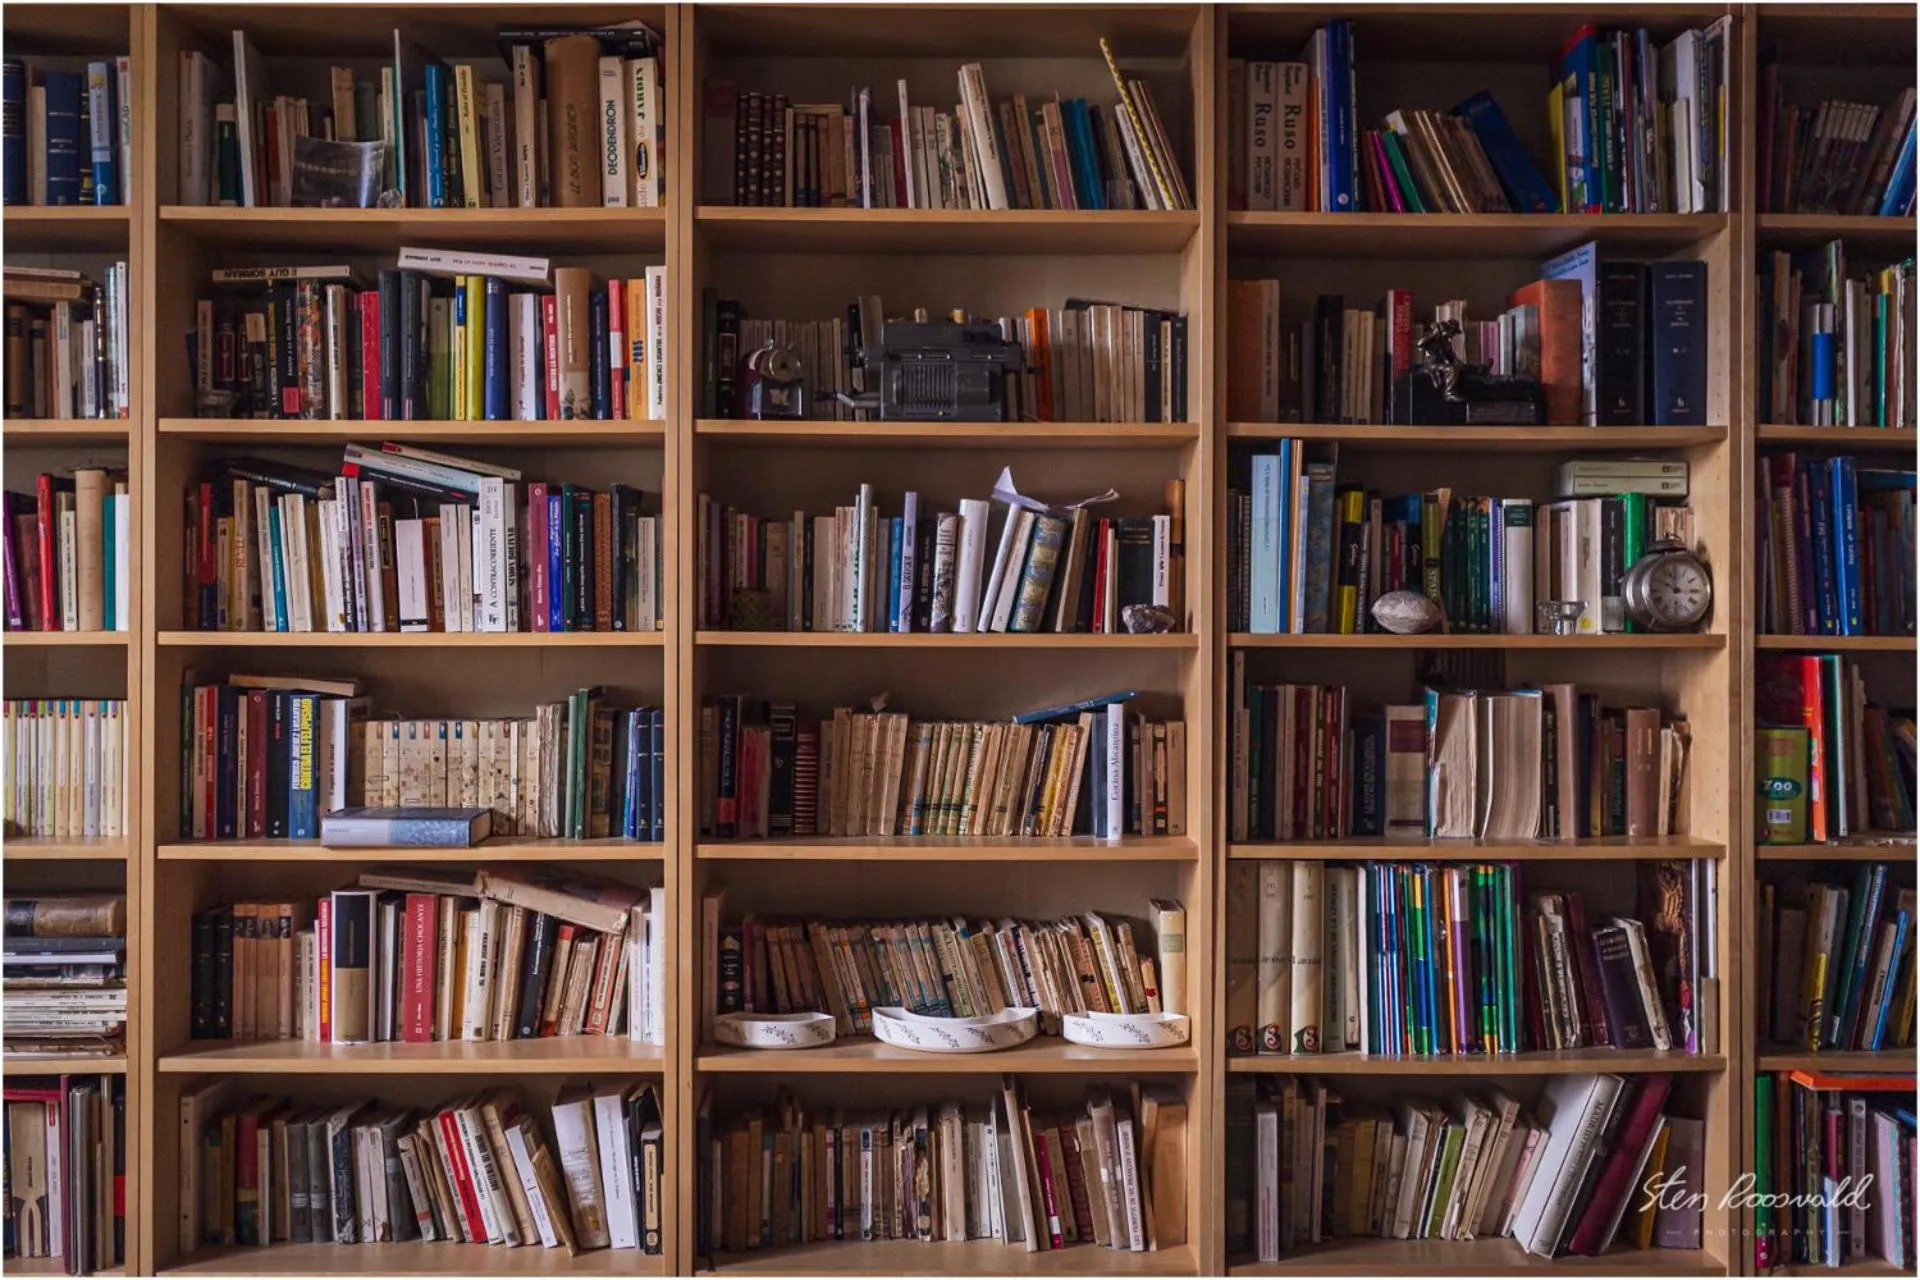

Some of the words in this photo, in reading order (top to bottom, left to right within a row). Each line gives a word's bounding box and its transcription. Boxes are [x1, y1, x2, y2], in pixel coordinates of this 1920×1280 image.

[635, 66, 645, 120] JARDIN
[605, 99, 618, 176] DEODENDRON
[1253, 103, 1273, 148] Ruso
[1284, 104, 1303, 149] Ruso
[224, 267, 266, 279] SORMAN
[269, 267, 289, 276] GUY
[488, 528, 498, 598] CONTRACORRIENTE
[489, 600, 498, 608] A
[301, 697, 312, 744] FELIPISMO
[301, 754, 312, 790] CONTRA
[416, 902, 425, 943] CHOCANTE
[415, 943, 424, 977] HISTORIA
[415, 977, 424, 994] UNA
